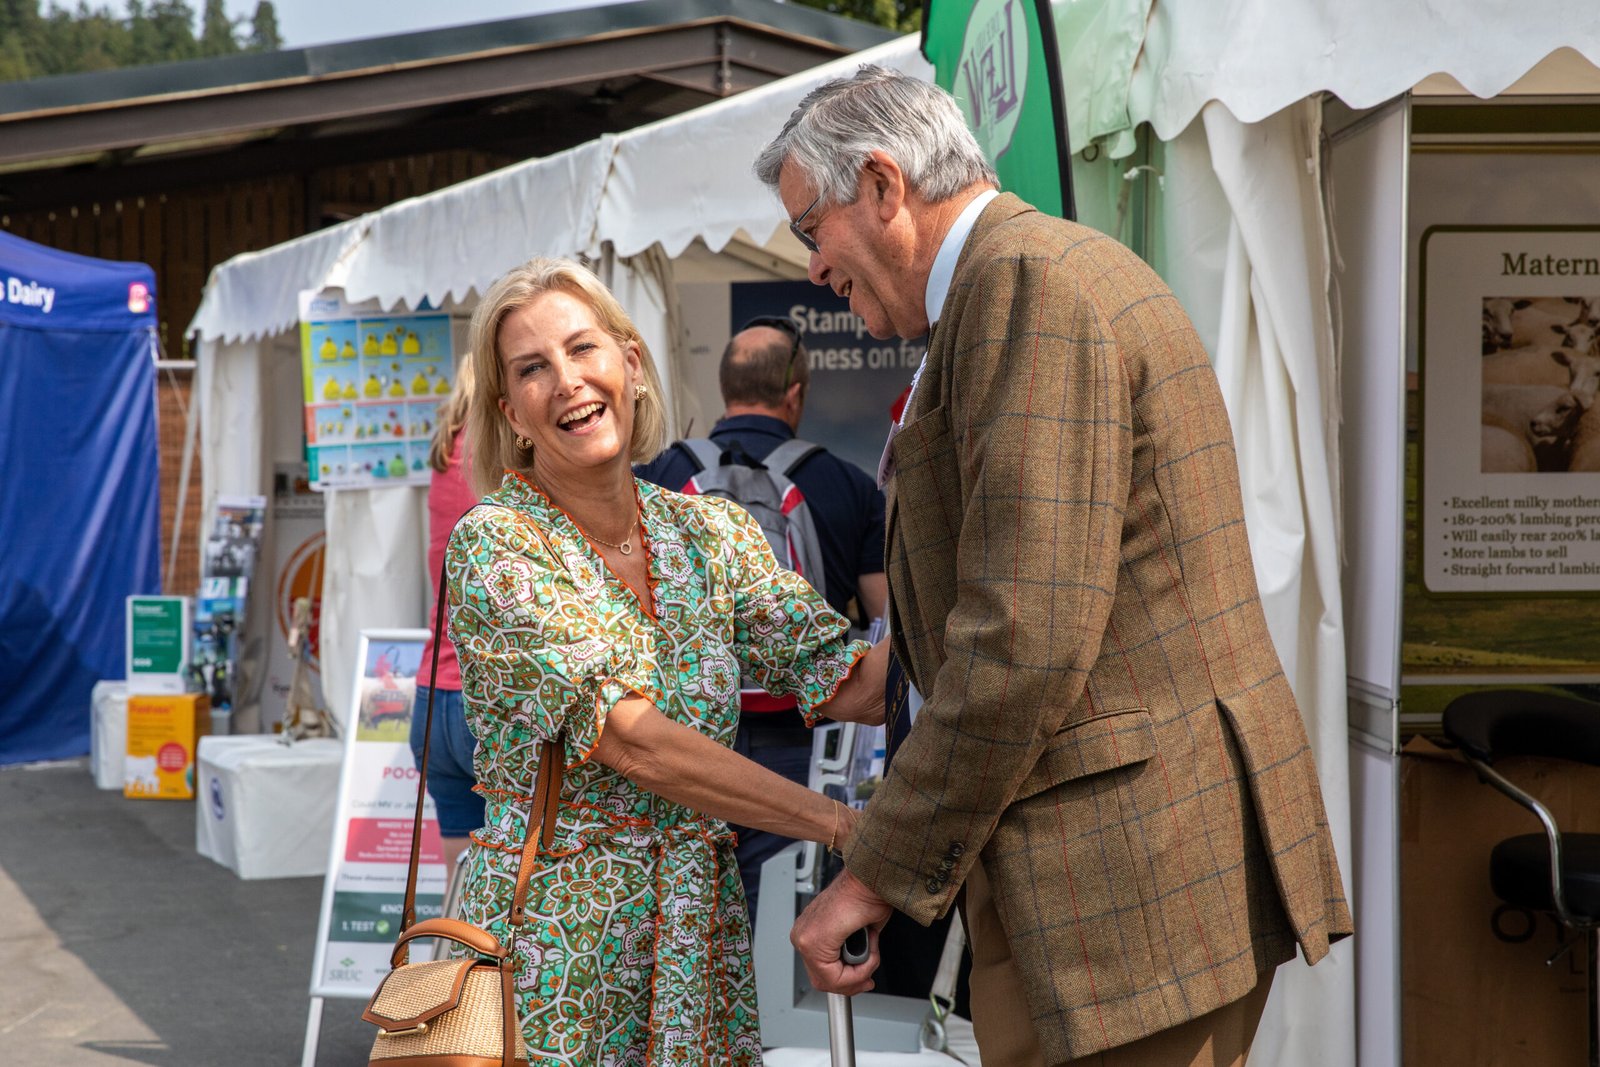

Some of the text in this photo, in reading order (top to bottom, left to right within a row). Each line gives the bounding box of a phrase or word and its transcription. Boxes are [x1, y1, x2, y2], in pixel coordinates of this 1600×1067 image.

[7, 277, 56, 313] Dairy
[789, 304, 868, 339] Stamp
[809, 340, 928, 370] ness on far
[1451, 495, 1600, 511] Excellent milky mother
[1451, 513, 1516, 526] 180-200%
[1520, 513, 1572, 527] lambing
[1451, 530, 1477, 542] Will
[1481, 530, 1518, 544] easily
[1521, 532, 1547, 542] rear
[1550, 530, 1587, 542] 200%
[1451, 545, 1568, 559] More lambs to sell
[1450, 563, 1502, 578] Straight
[1506, 563, 1555, 576] forward
[382, 766, 421, 781] POO
[380, 904, 404, 915] KNO
[351, 921, 375, 932] TEST
